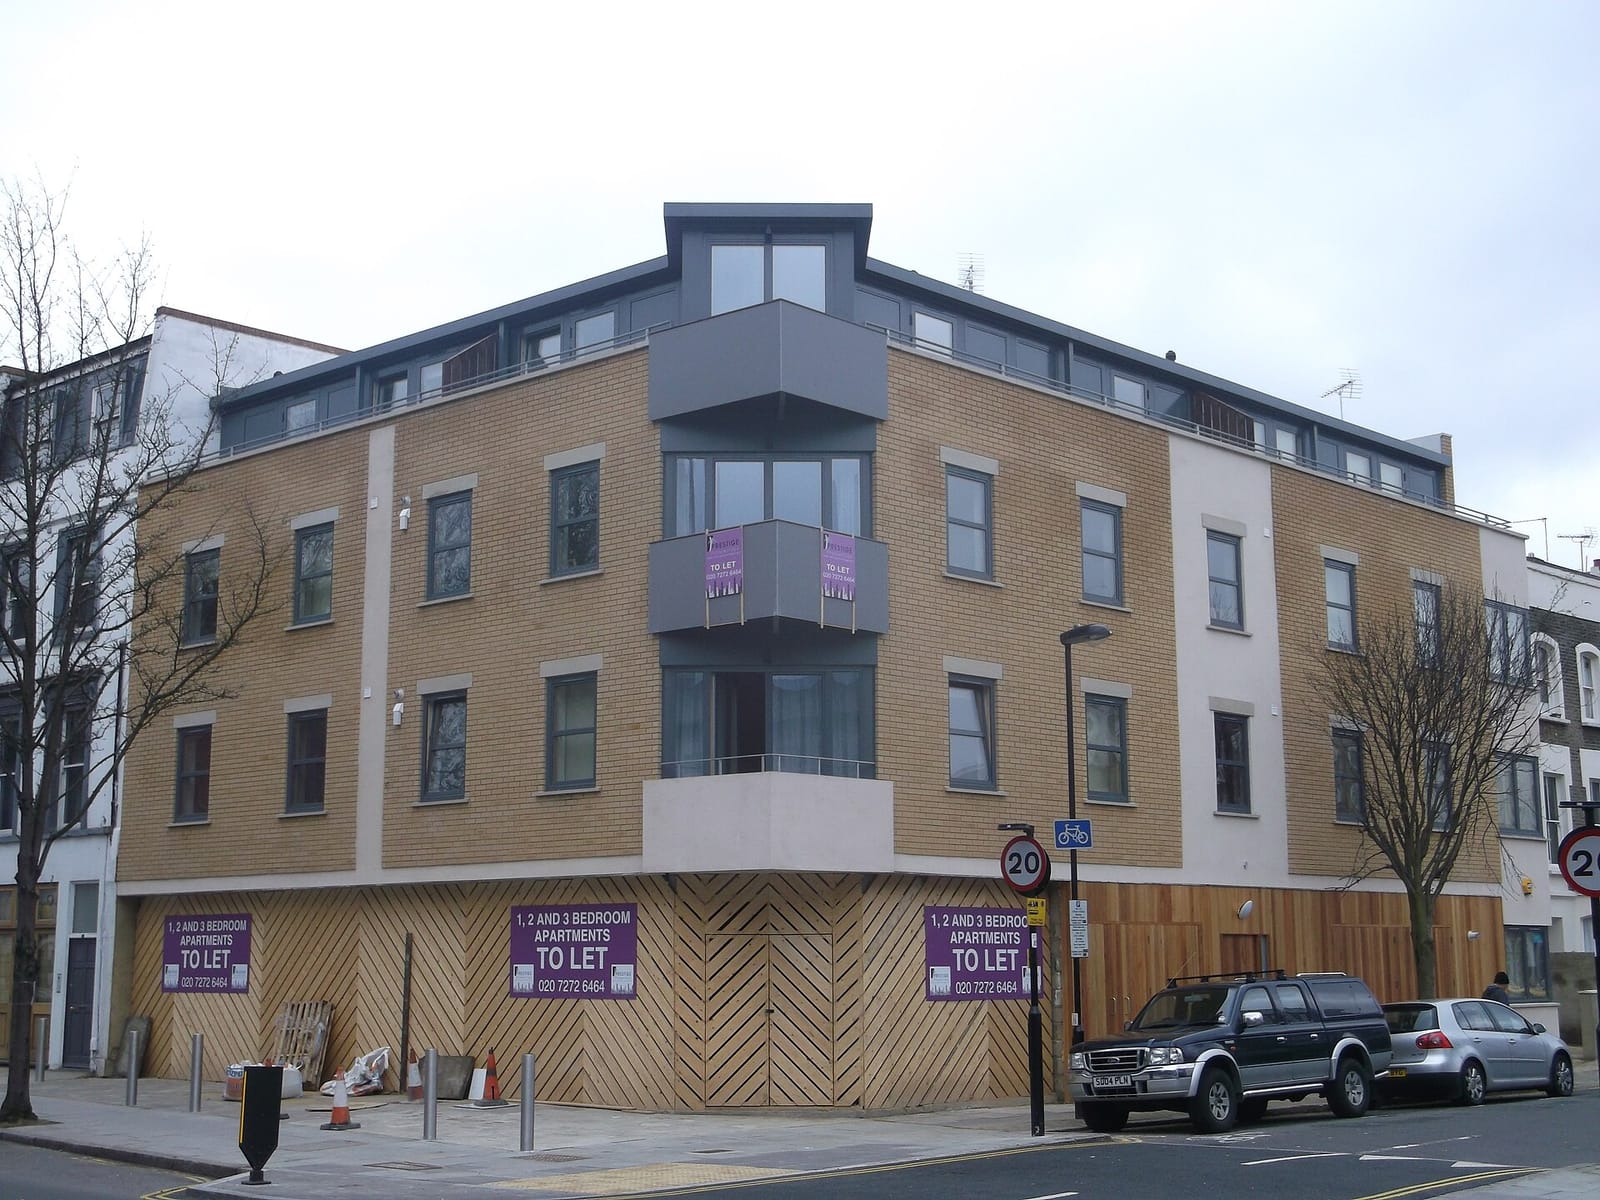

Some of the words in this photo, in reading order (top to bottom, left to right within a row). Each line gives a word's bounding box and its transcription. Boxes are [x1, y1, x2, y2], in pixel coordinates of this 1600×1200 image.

[710, 563, 720, 572] TO
[723, 561, 736, 570] LET
[837, 566, 850, 574] LET
[1009, 851, 1040, 874] 20
[1573, 851, 1600, 876] 2
[516, 913, 526, 928] 1,
[528, 913, 534, 926] 2
[536, 912, 560, 925] AND
[563, 912, 570, 925] 3
[572, 911, 631, 925] BEDROOM
[931, 913, 940, 928] 1,
[943, 914, 949, 926] 2
[952, 914, 974, 927] AND
[976, 915, 983, 927] 3
[985, 915, 1028, 928] BEDROO
[169, 922, 175, 935] 1,
[176, 921, 181, 932] 2
[182, 921, 199, 932] AND
[200, 921, 205, 932] 3
[206, 920, 247, 931] BEDROOM
[180, 934, 233, 946] APARTMENTS
[534, 928, 611, 942] APARTMENTS
[950, 931, 1021, 944] APARTMENTS
[181, 949, 200, 969] TO
[204, 949, 231, 969] LET
[536, 946, 564, 970] TO
[570, 947, 608, 970] LET
[952, 948, 979, 972] TO
[984, 949, 1019, 971] LET
[181, 976, 194, 988] 020
[195, 976, 211, 988] 7272
[211, 977, 228, 988] 6464
[538, 979, 556, 992] 020
[558, 979, 580, 992] 7272
[582, 980, 605, 992] 6464
[955, 981, 972, 994] 020
[973, 981, 994, 993] 7272
[996, 981, 1017, 993] 6464
[1114, 1076, 1129, 1085] PLN
